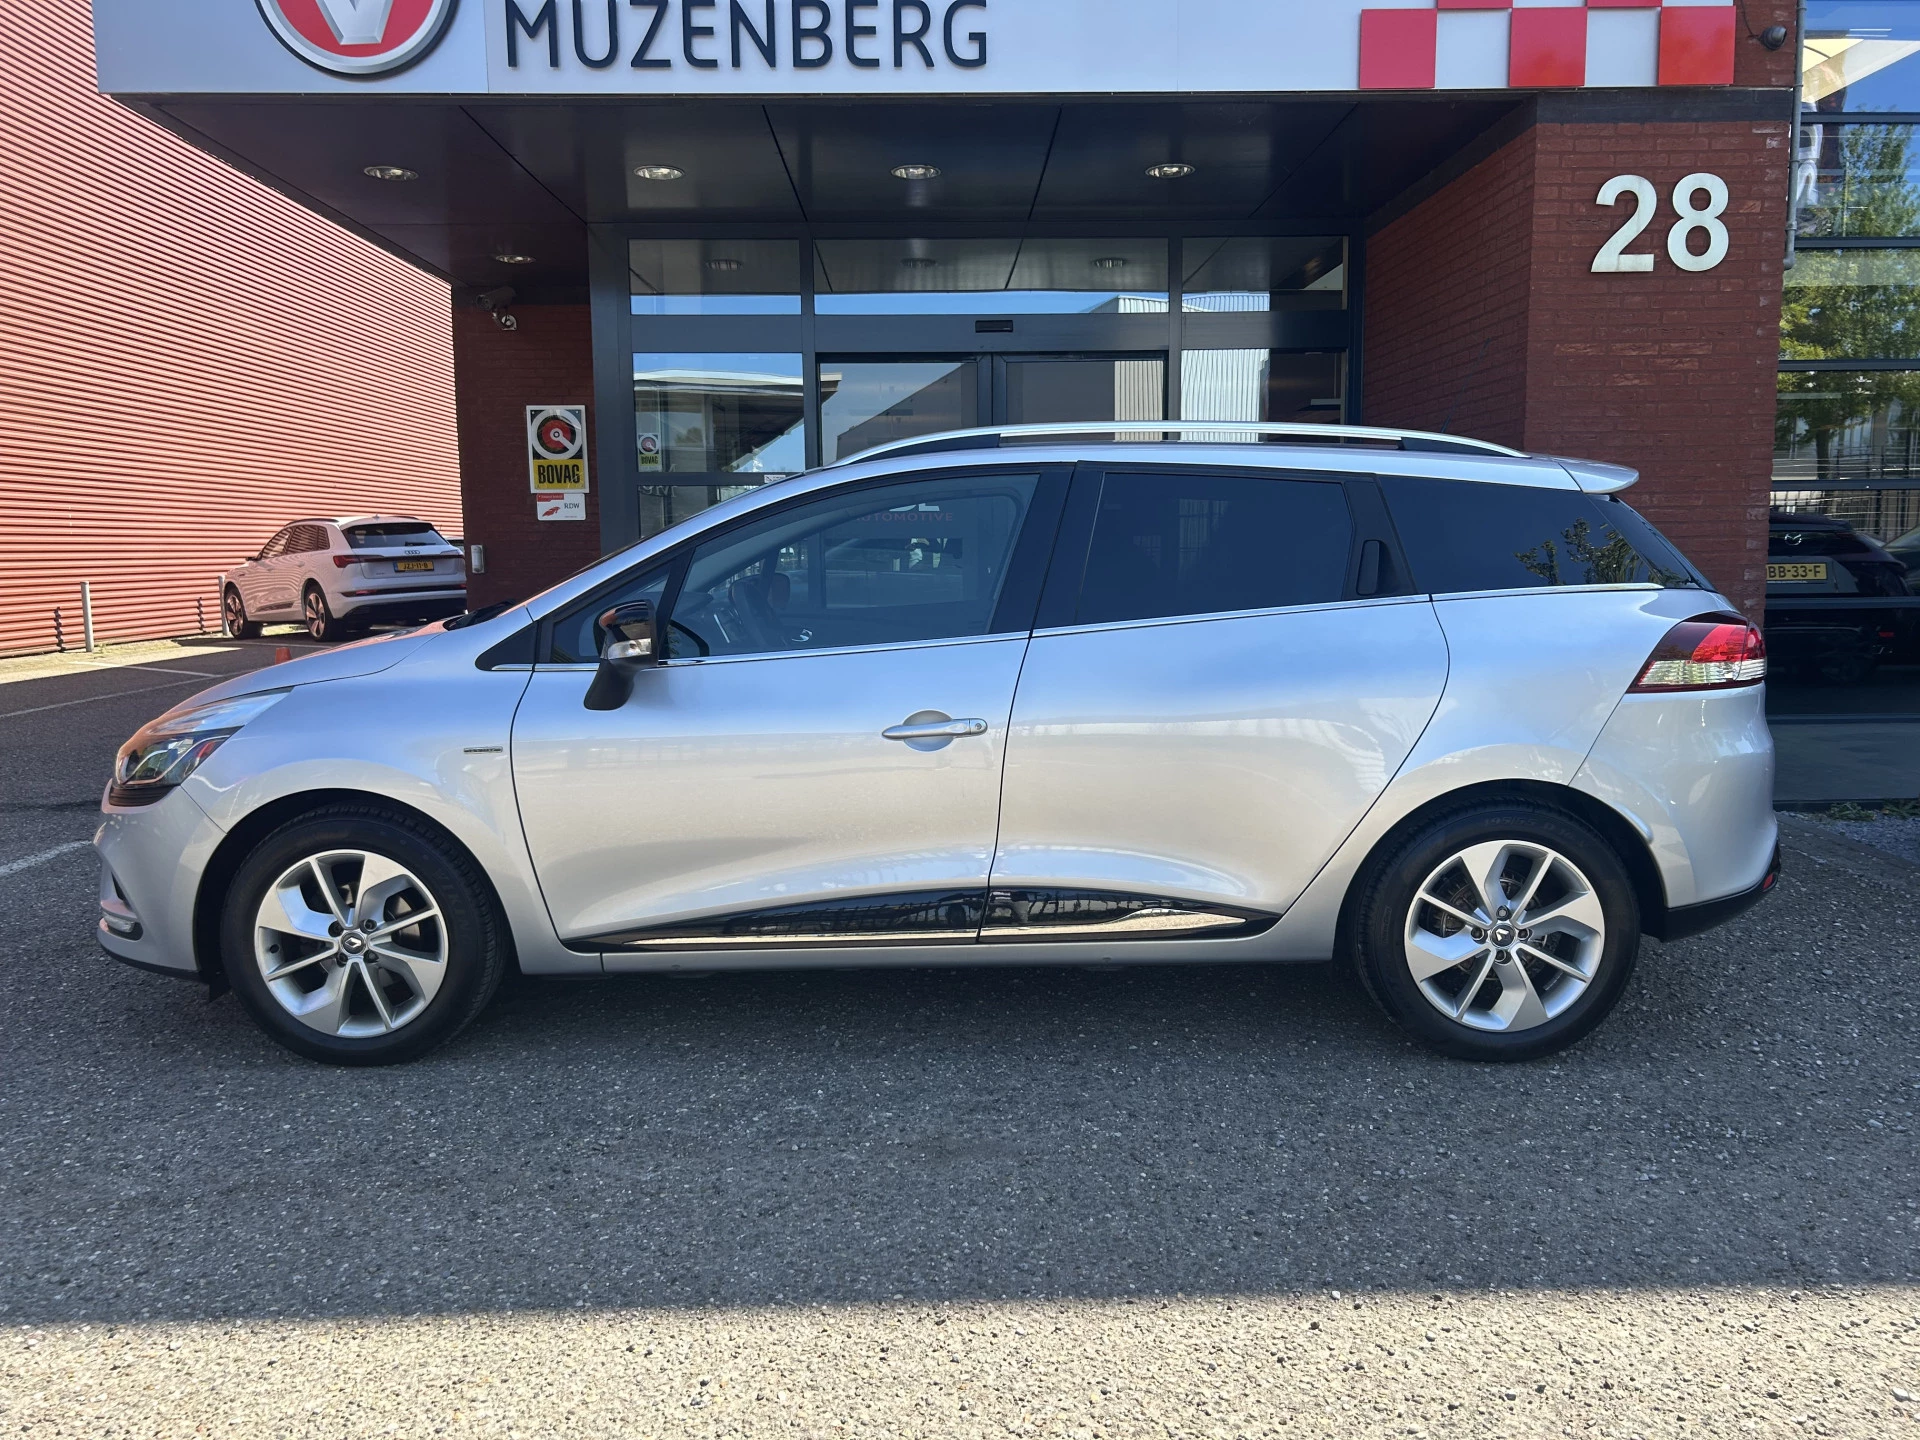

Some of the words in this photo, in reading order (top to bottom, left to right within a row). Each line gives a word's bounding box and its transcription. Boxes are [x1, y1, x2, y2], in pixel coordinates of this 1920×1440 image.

[504, 0, 987, 69] MUZENBERG
[1591, 172, 1729, 272] 28
[640, 455, 659, 465] BOVAG
[537, 464, 580, 484] BOVAG
[856, 512, 953, 522] UTOMOTIVE
